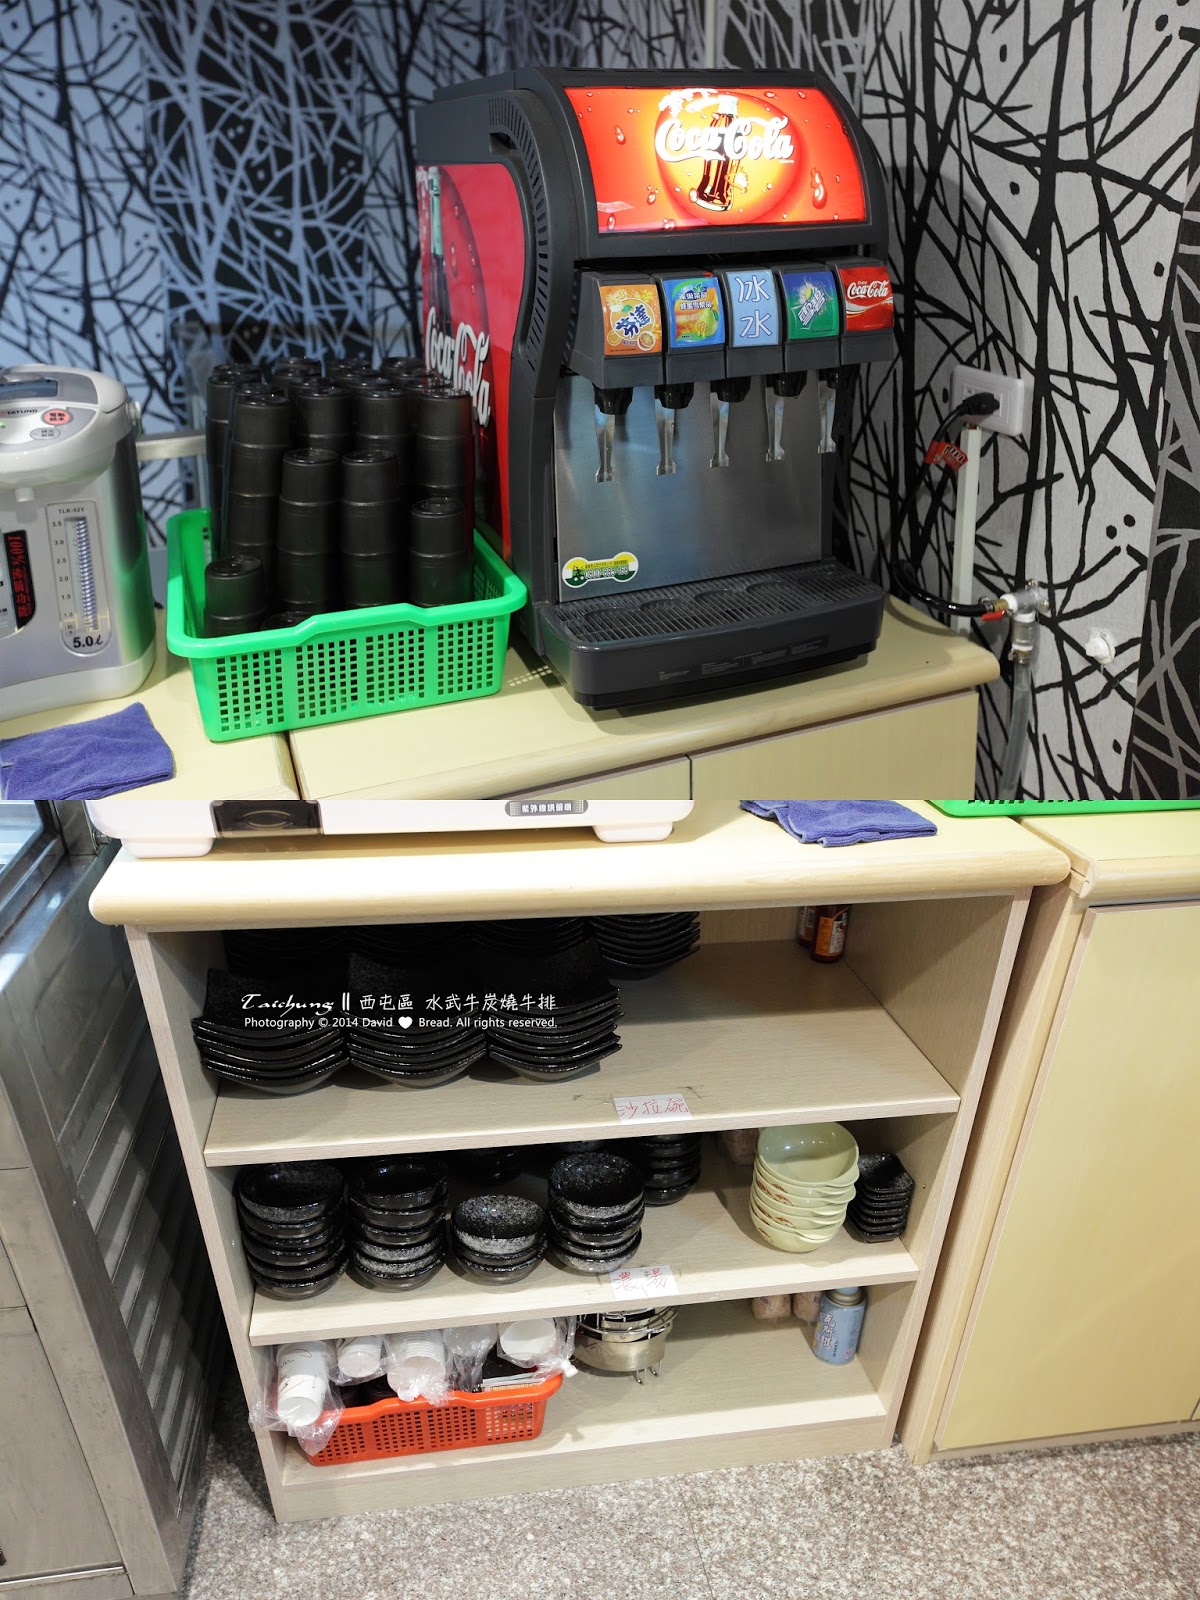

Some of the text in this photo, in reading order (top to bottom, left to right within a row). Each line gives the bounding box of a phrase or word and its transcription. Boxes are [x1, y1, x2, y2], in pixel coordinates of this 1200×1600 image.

[655, 115, 795, 162] Coca-Cola
[847, 280, 889, 299] Coca-Cola
[615, 303, 651, 338] 芬達
[616, 1097, 689, 1119] 沙拉碗
